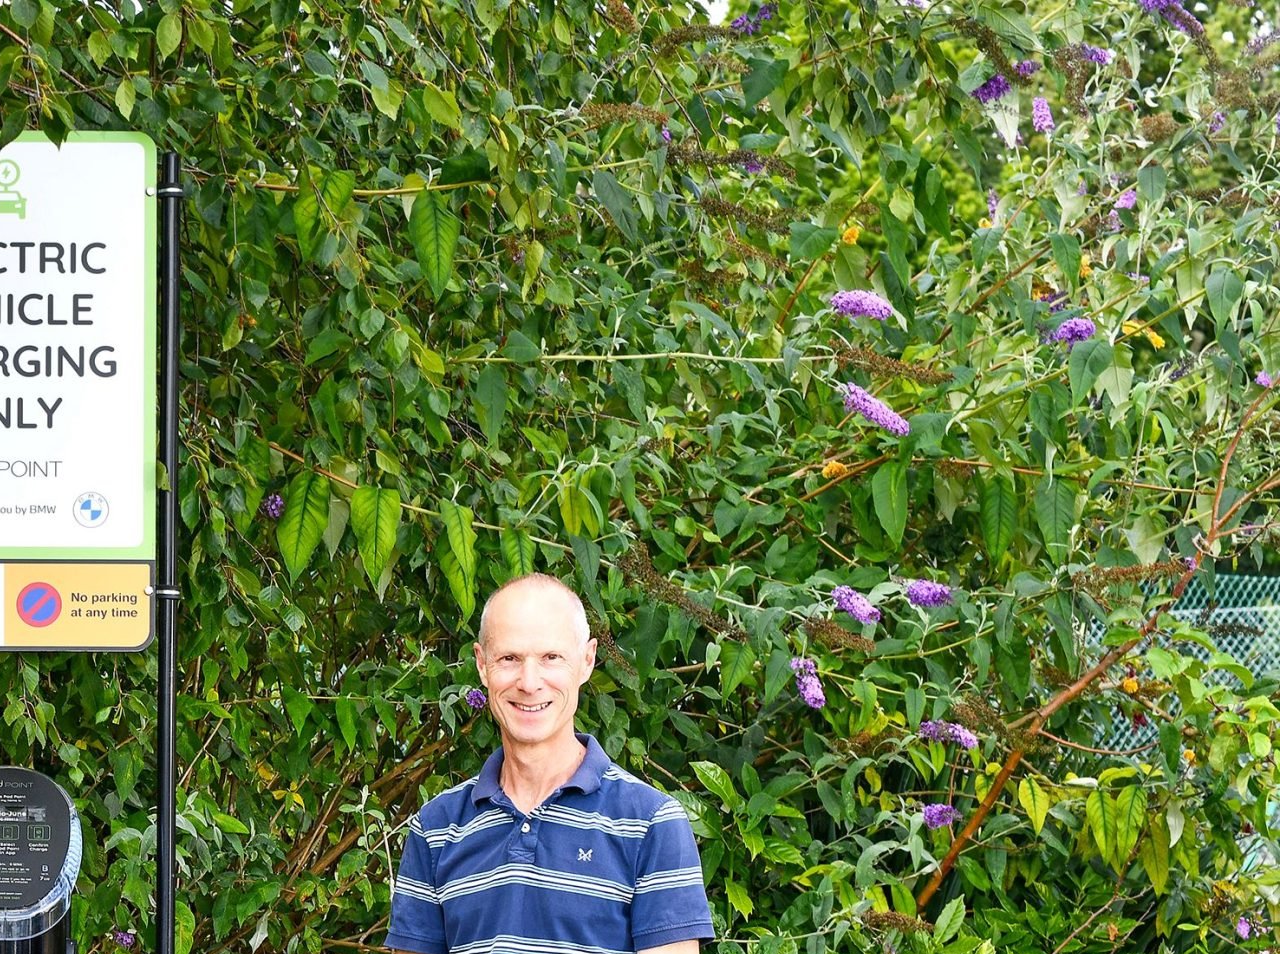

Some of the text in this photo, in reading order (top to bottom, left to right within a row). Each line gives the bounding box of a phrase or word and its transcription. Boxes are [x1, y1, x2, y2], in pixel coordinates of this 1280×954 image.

[15, 504, 27, 517] by
[29, 504, 57, 515] BMW
[71, 592, 138, 605] No parking
[70, 607, 138, 620] at any time
[41, 864, 49, 872] B
